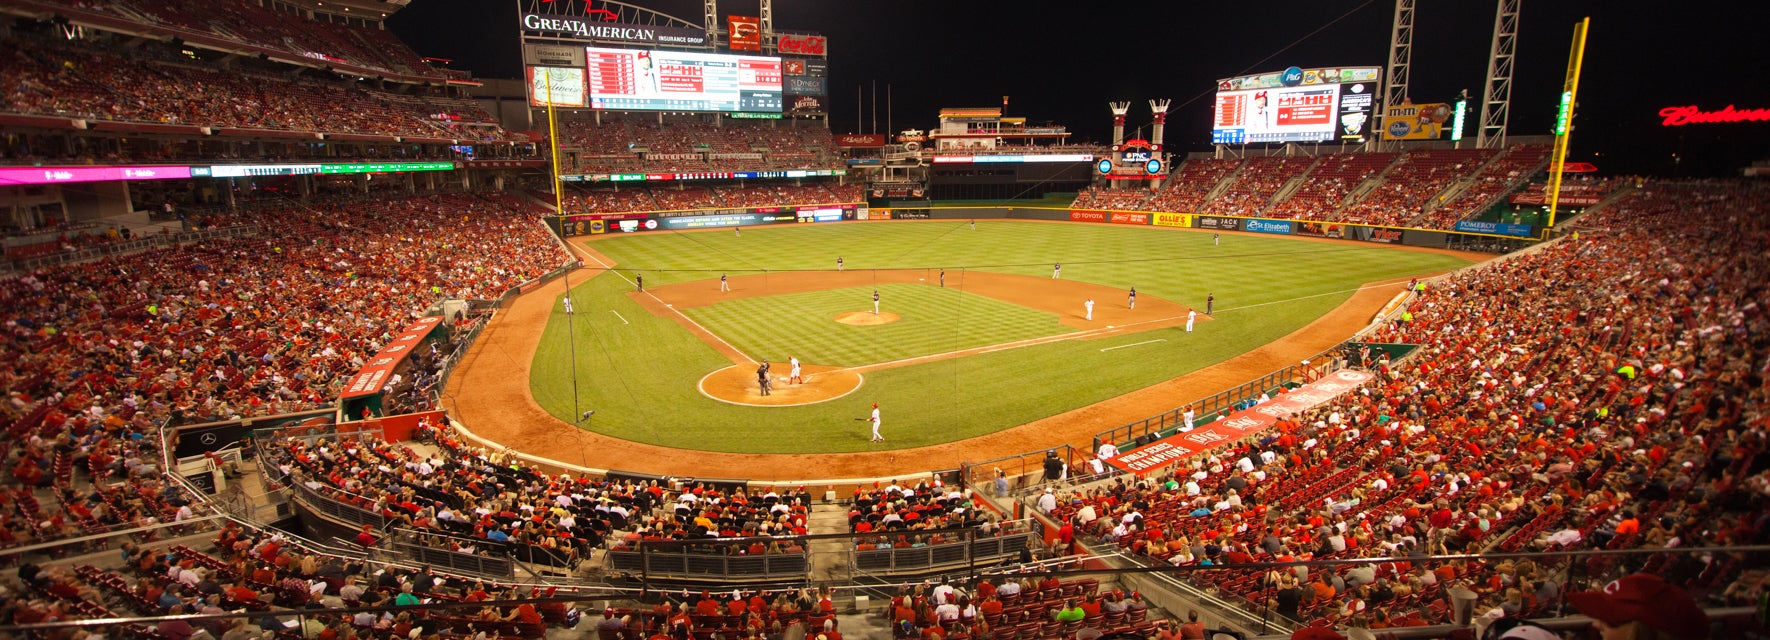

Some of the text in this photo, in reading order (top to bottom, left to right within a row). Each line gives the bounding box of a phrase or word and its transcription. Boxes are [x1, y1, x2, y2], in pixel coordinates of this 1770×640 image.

[524, 14, 654, 40] GREAT AMERICAN
[1460, 221, 1496, 229] POMEROY
[1117, 442, 1173, 463] WORLD SERIES
[1128, 446, 1191, 470] CHAMPIONS
